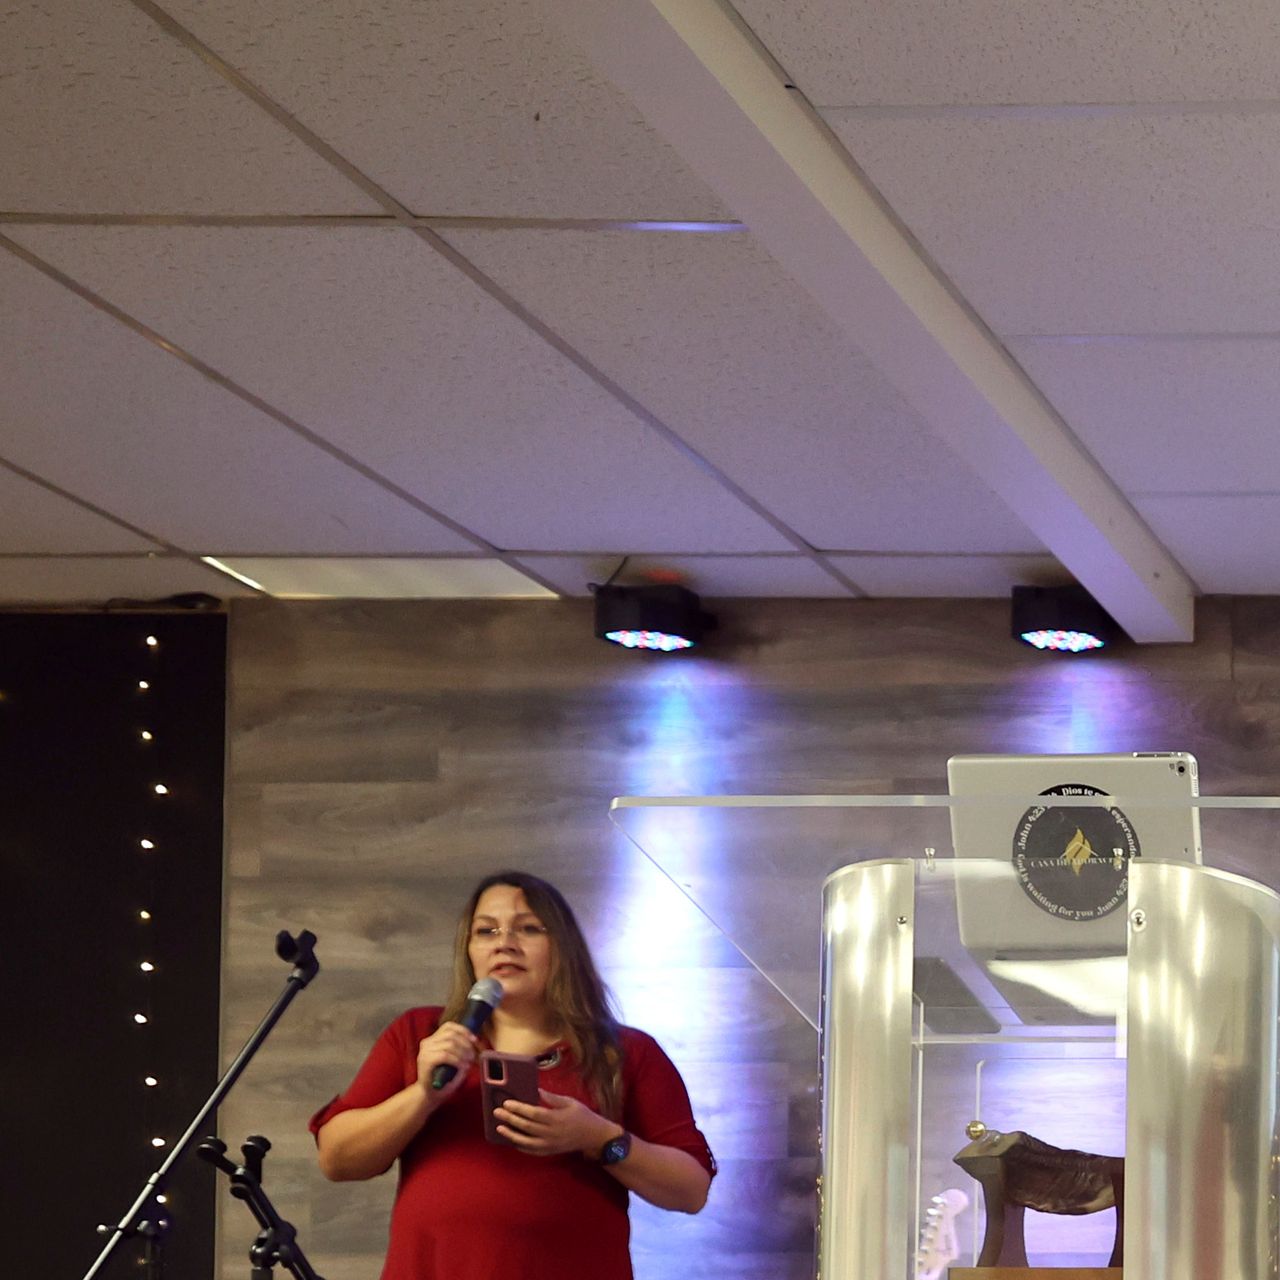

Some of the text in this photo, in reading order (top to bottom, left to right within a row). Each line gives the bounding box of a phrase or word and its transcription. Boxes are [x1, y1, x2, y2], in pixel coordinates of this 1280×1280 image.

[1017, 823, 1033, 850] John
[1061, 787, 1083, 796] Dios
[1084, 788, 1094, 796] te
[1111, 809, 1138, 857] esperando
[1027, 883, 1058, 913] waiting
[1058, 906, 1074, 916] for
[1074, 910, 1093, 920] you
[1097, 897, 1118, 915] Juan
